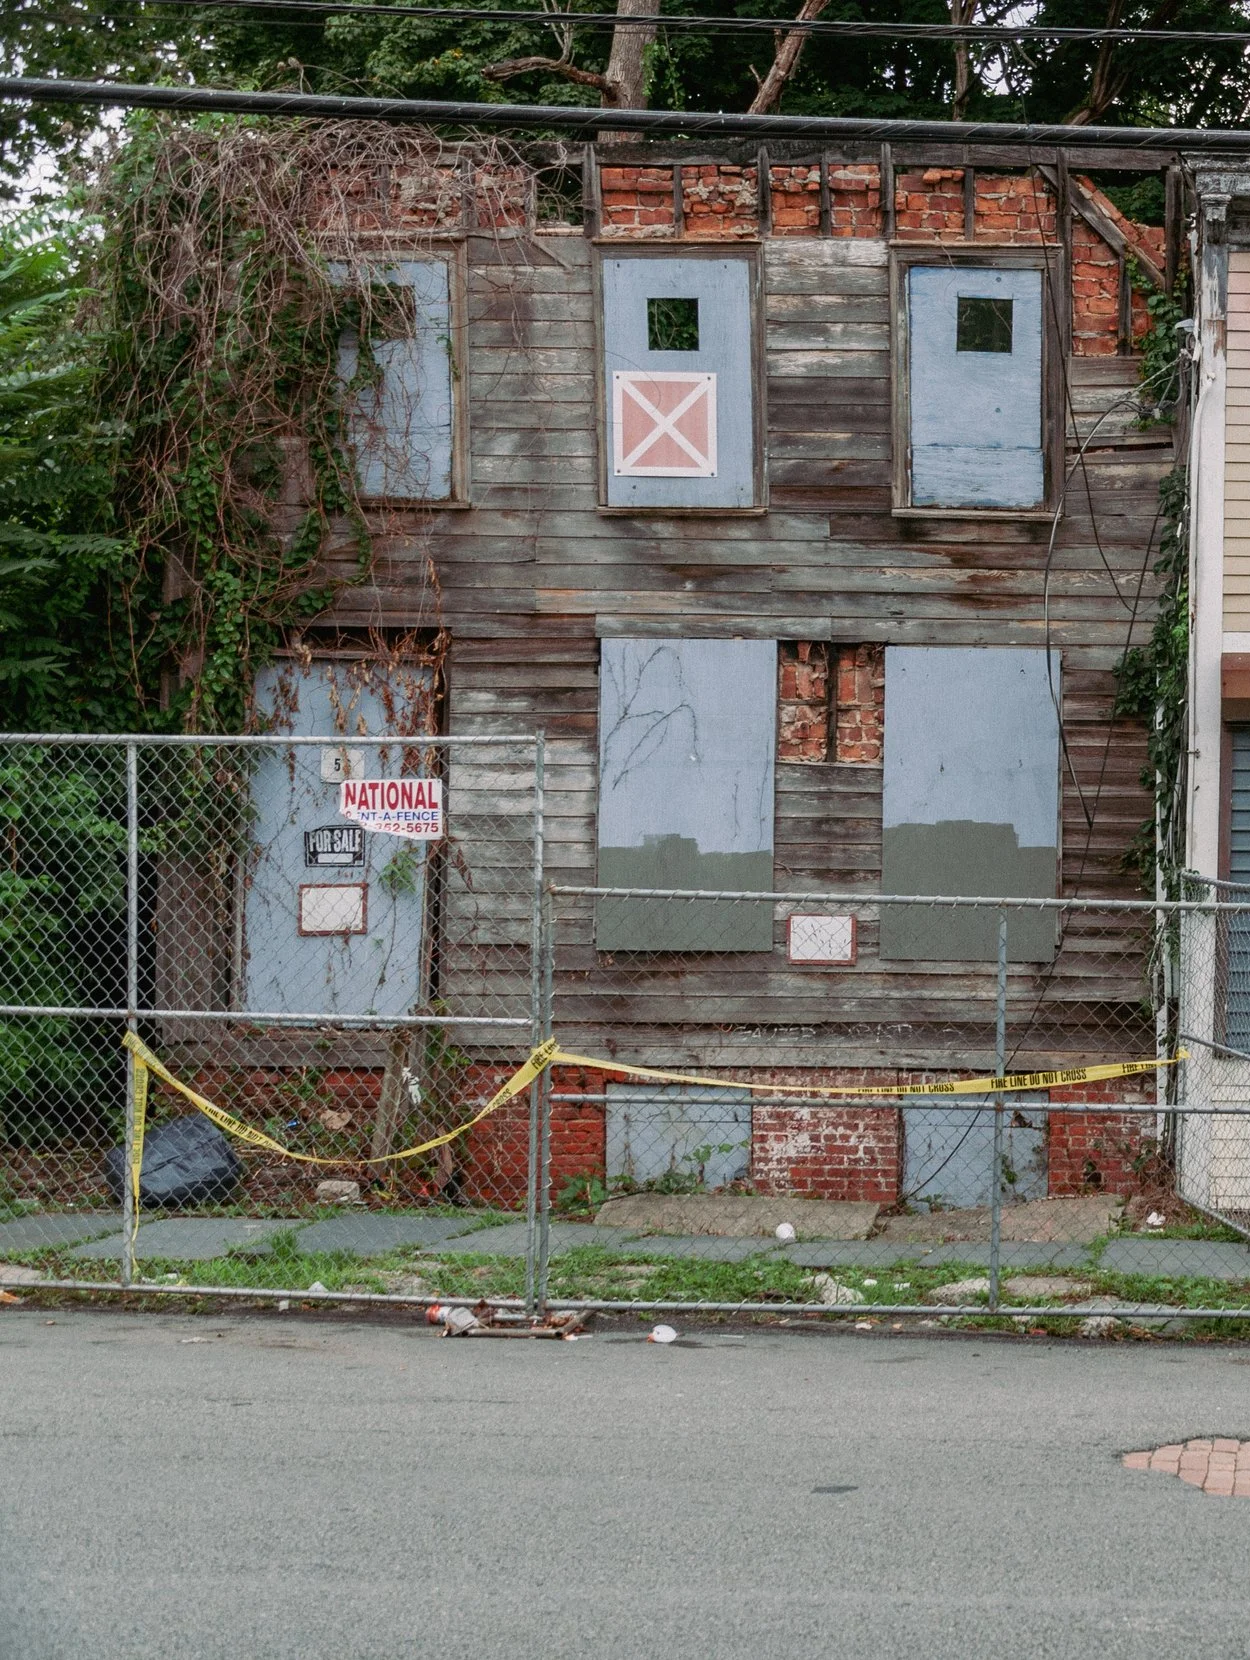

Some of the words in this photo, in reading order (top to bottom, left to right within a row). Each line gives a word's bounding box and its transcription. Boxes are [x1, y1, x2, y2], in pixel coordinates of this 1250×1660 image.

[345, 781, 439, 810] NATIONAL
[357, 811, 439, 821] NT-A-FENCE
[309, 830, 332, 853] FOR
[334, 829, 361, 853] SALE
[531, 1052, 548, 1070] FIRE
[990, 1076, 1008, 1089] FIRE
[1009, 1075, 1028, 1088] LINE
[1029, 1074, 1040, 1086] DO
[1042, 1071, 1059, 1085] NOT
[1061, 1068, 1087, 1082] CROSS
